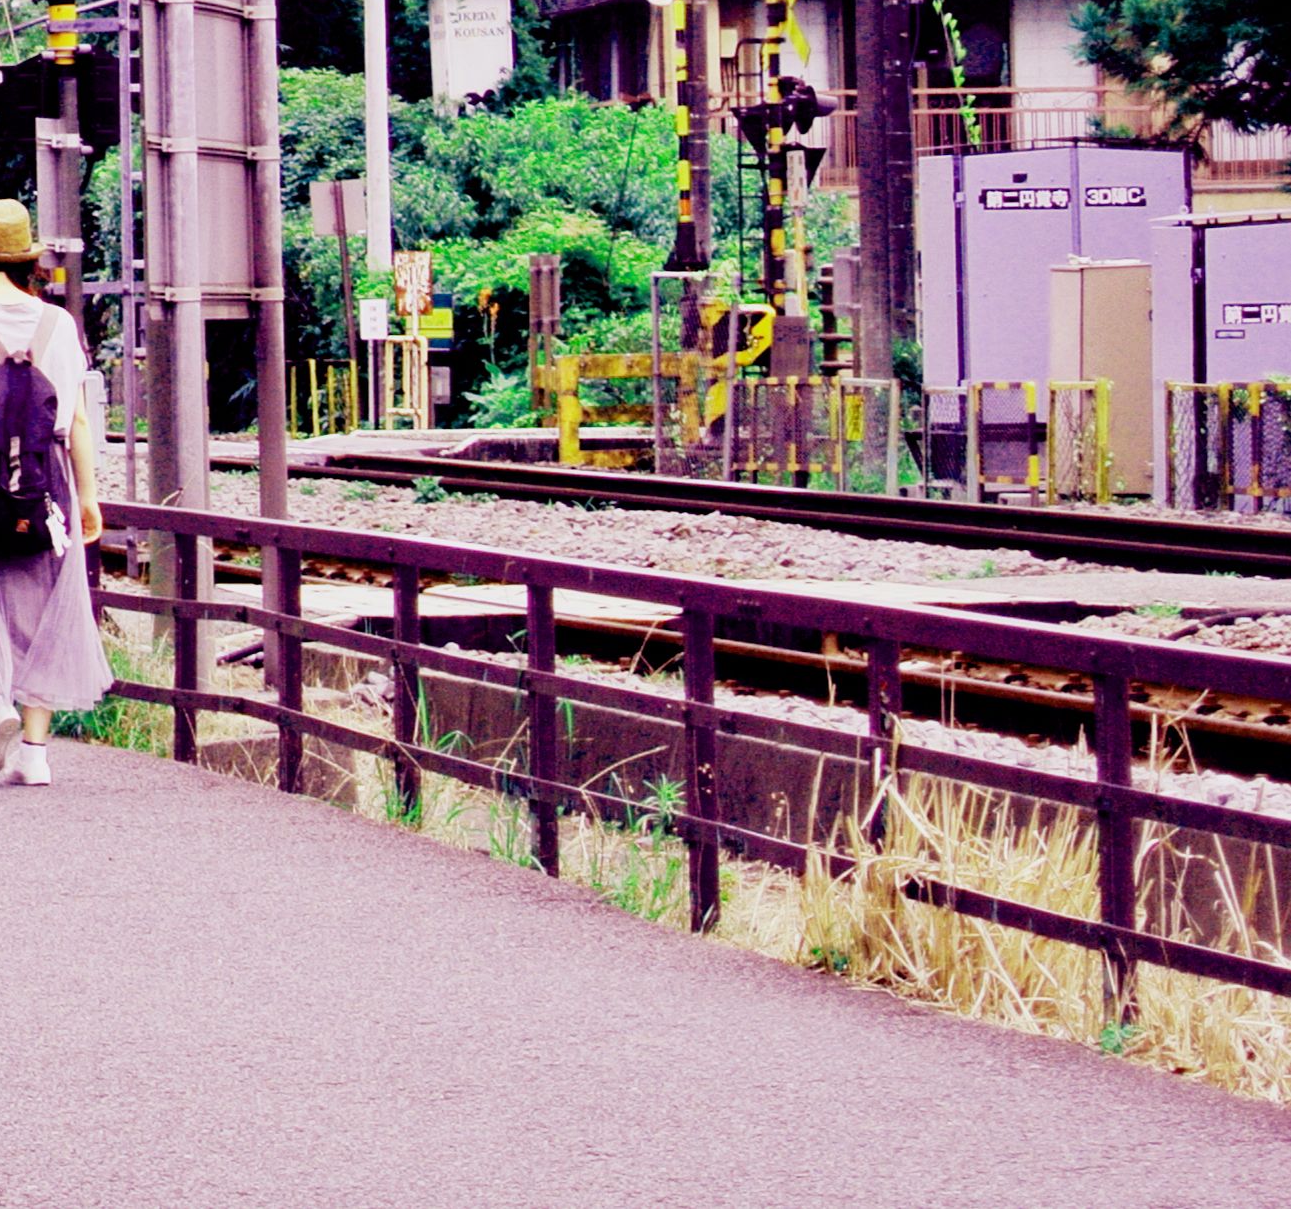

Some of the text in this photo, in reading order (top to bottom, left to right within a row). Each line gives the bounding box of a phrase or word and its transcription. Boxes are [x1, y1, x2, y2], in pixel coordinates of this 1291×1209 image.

[459, 11, 496, 21] IKEDA
[455, 27, 504, 37] KOUSAN
[987, 191, 1068, 208] 第二円覚寺
